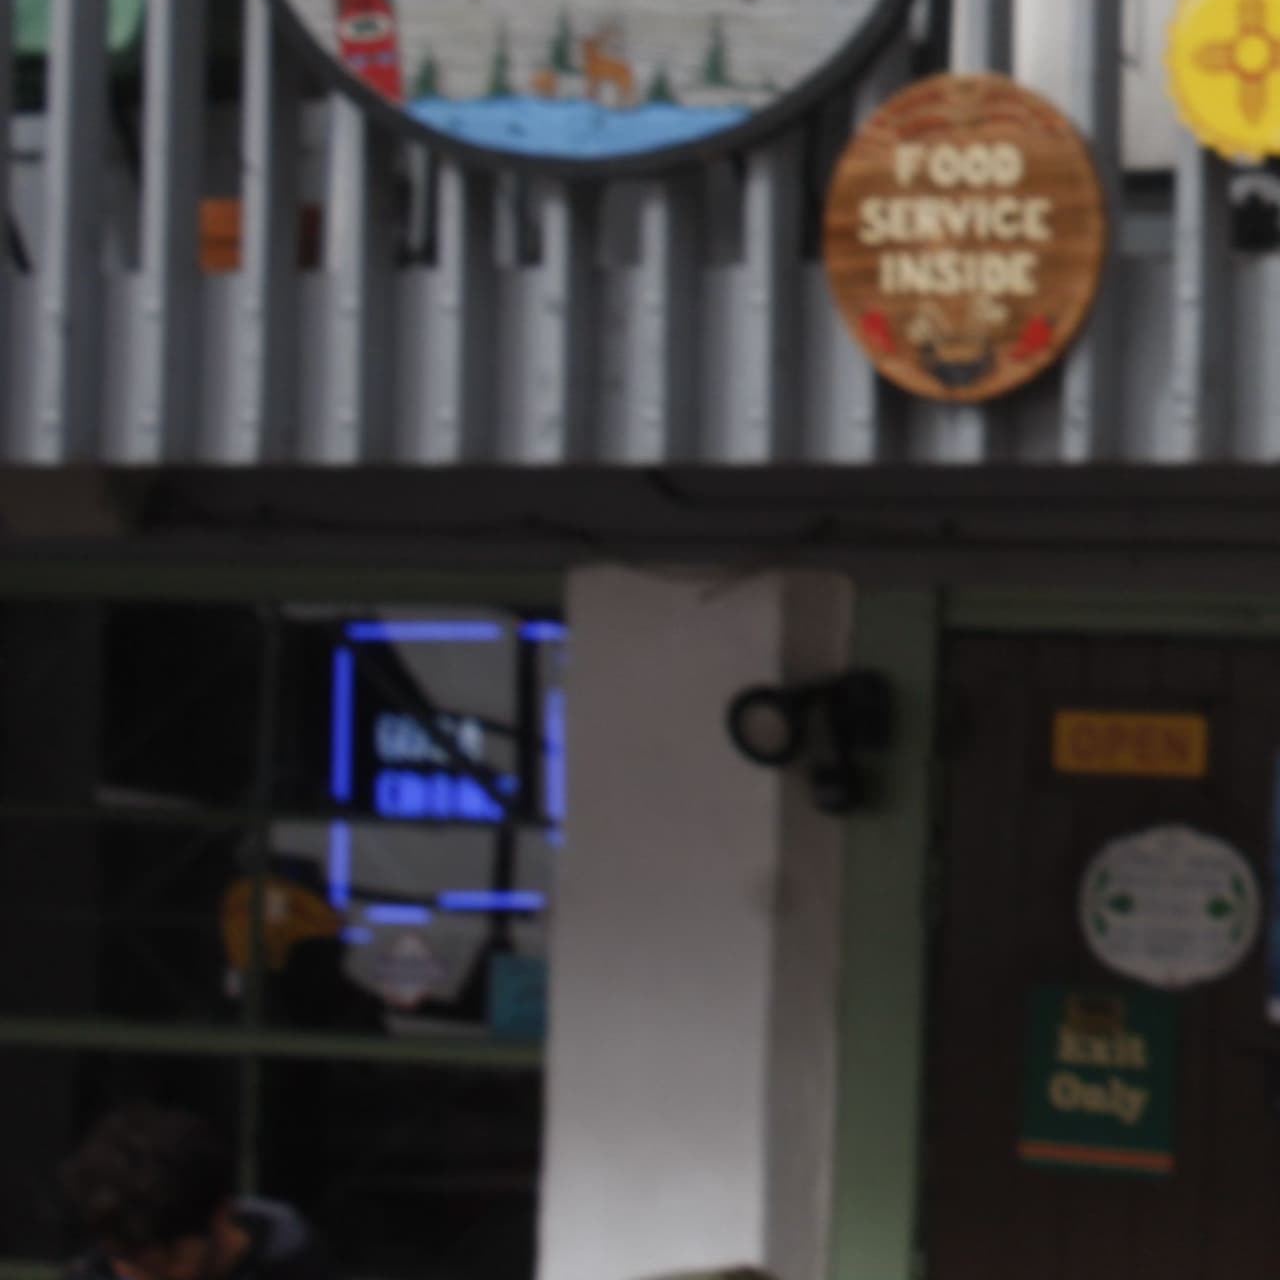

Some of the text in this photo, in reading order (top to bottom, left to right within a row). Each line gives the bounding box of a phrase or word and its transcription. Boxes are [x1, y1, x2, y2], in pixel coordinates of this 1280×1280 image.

[893, 140, 1024, 190] FOOD
[857, 193, 1054, 247] SERVICE
[877, 250, 1040, 297] INSIDE
[1049, 1072, 1149, 1126] Only
